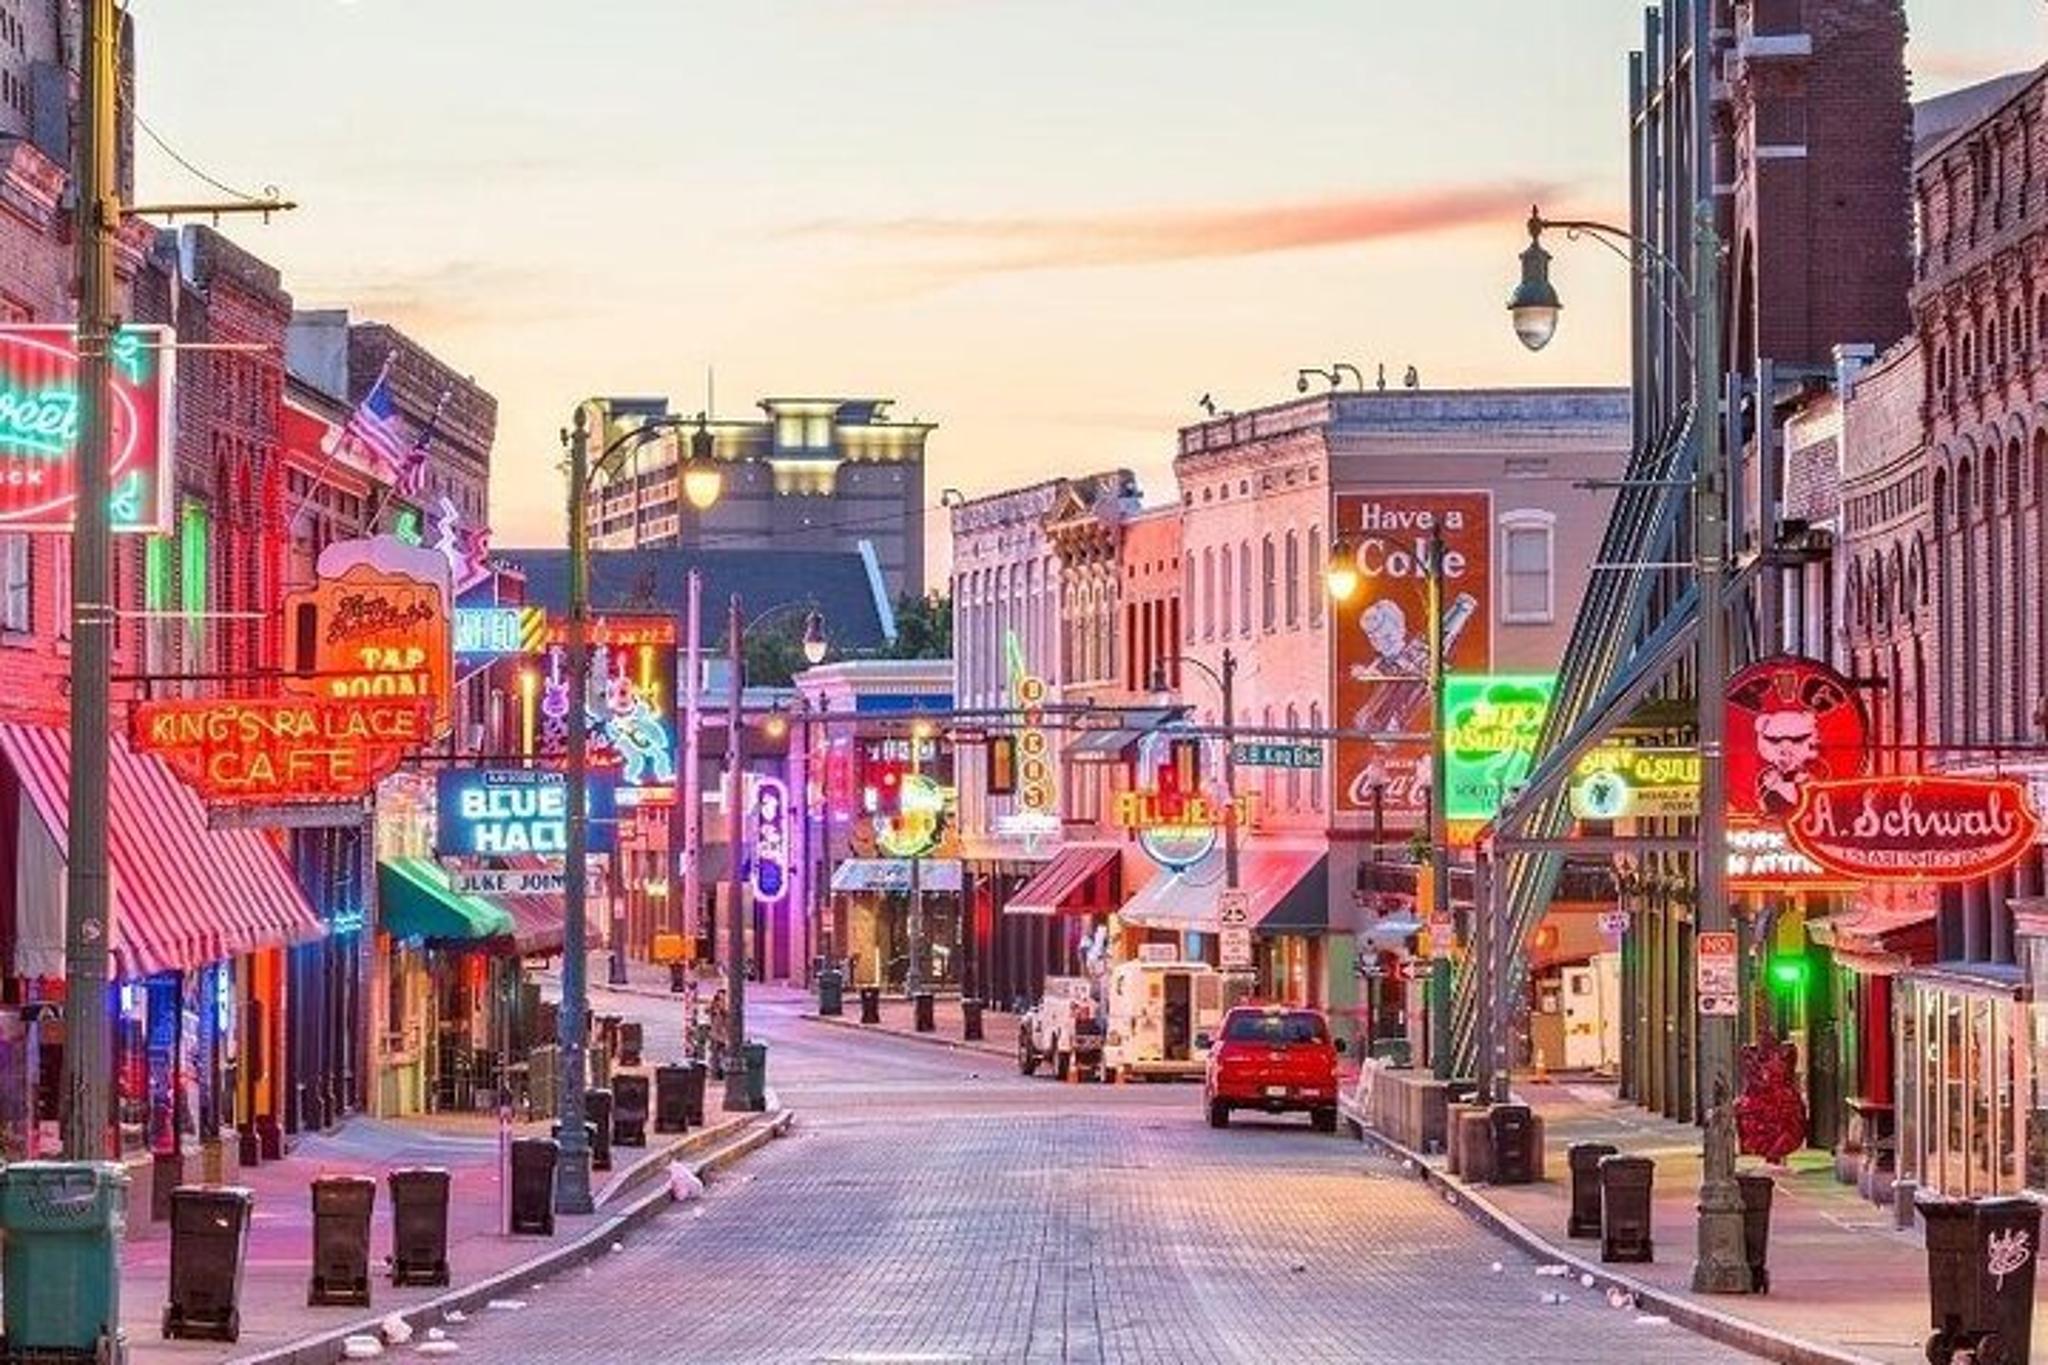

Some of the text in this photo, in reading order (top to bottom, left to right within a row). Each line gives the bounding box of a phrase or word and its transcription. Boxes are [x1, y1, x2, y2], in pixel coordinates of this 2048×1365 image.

[1362, 503, 1464, 530] Have a
[361, 647, 426, 671] TAP
[210, 749, 356, 785] CAFE
[460, 787, 590, 819] BLUE
[520, 873, 569, 892] JOIN
[1221, 908, 1247, 922] 25
